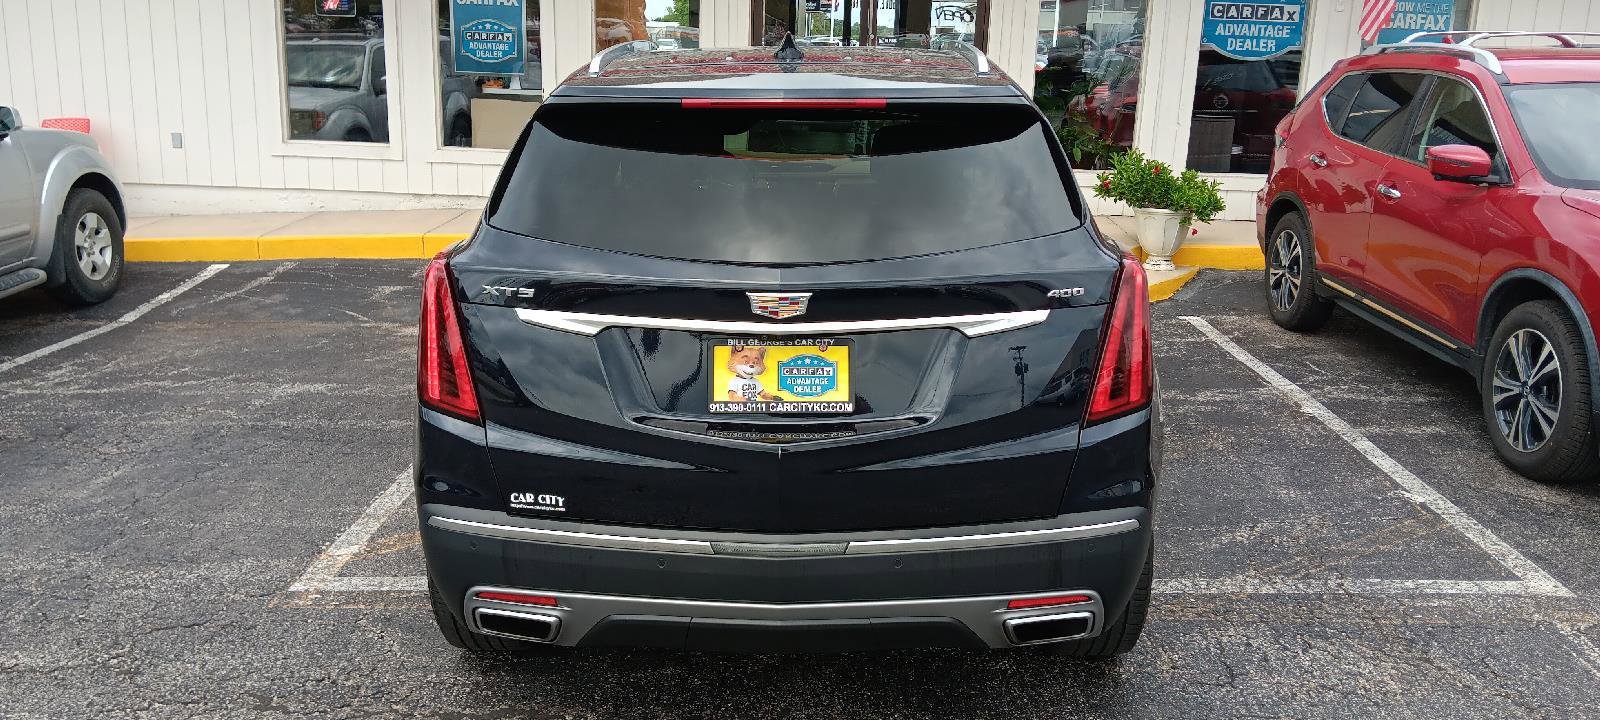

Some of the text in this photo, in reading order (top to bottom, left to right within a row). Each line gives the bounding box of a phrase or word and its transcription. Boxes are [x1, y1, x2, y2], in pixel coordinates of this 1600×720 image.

[1213, 5, 1296, 21] CARFAX
[1416, 3, 1430, 13] ME
[1432, 4, 1449, 14] THE
[1215, 23, 1291, 38] ADVANTAGE
[465, 32, 511, 41] CARFAX
[469, 42, 509, 51] ADVANTAGE
[1226, 38, 1276, 52] DEALER
[476, 50, 503, 58] DEALER
[1047, 287, 1085, 298] 400
[783, 367, 832, 376] CARFAX
[741, 383, 757, 391] CAR
[793, 386, 822, 394] DEALER
[742, 391, 758, 399] FOX
[709, 403, 853, 412] 913-390-0111 CARCITYKC.COM
[510, 492, 565, 507] CAR CITY
